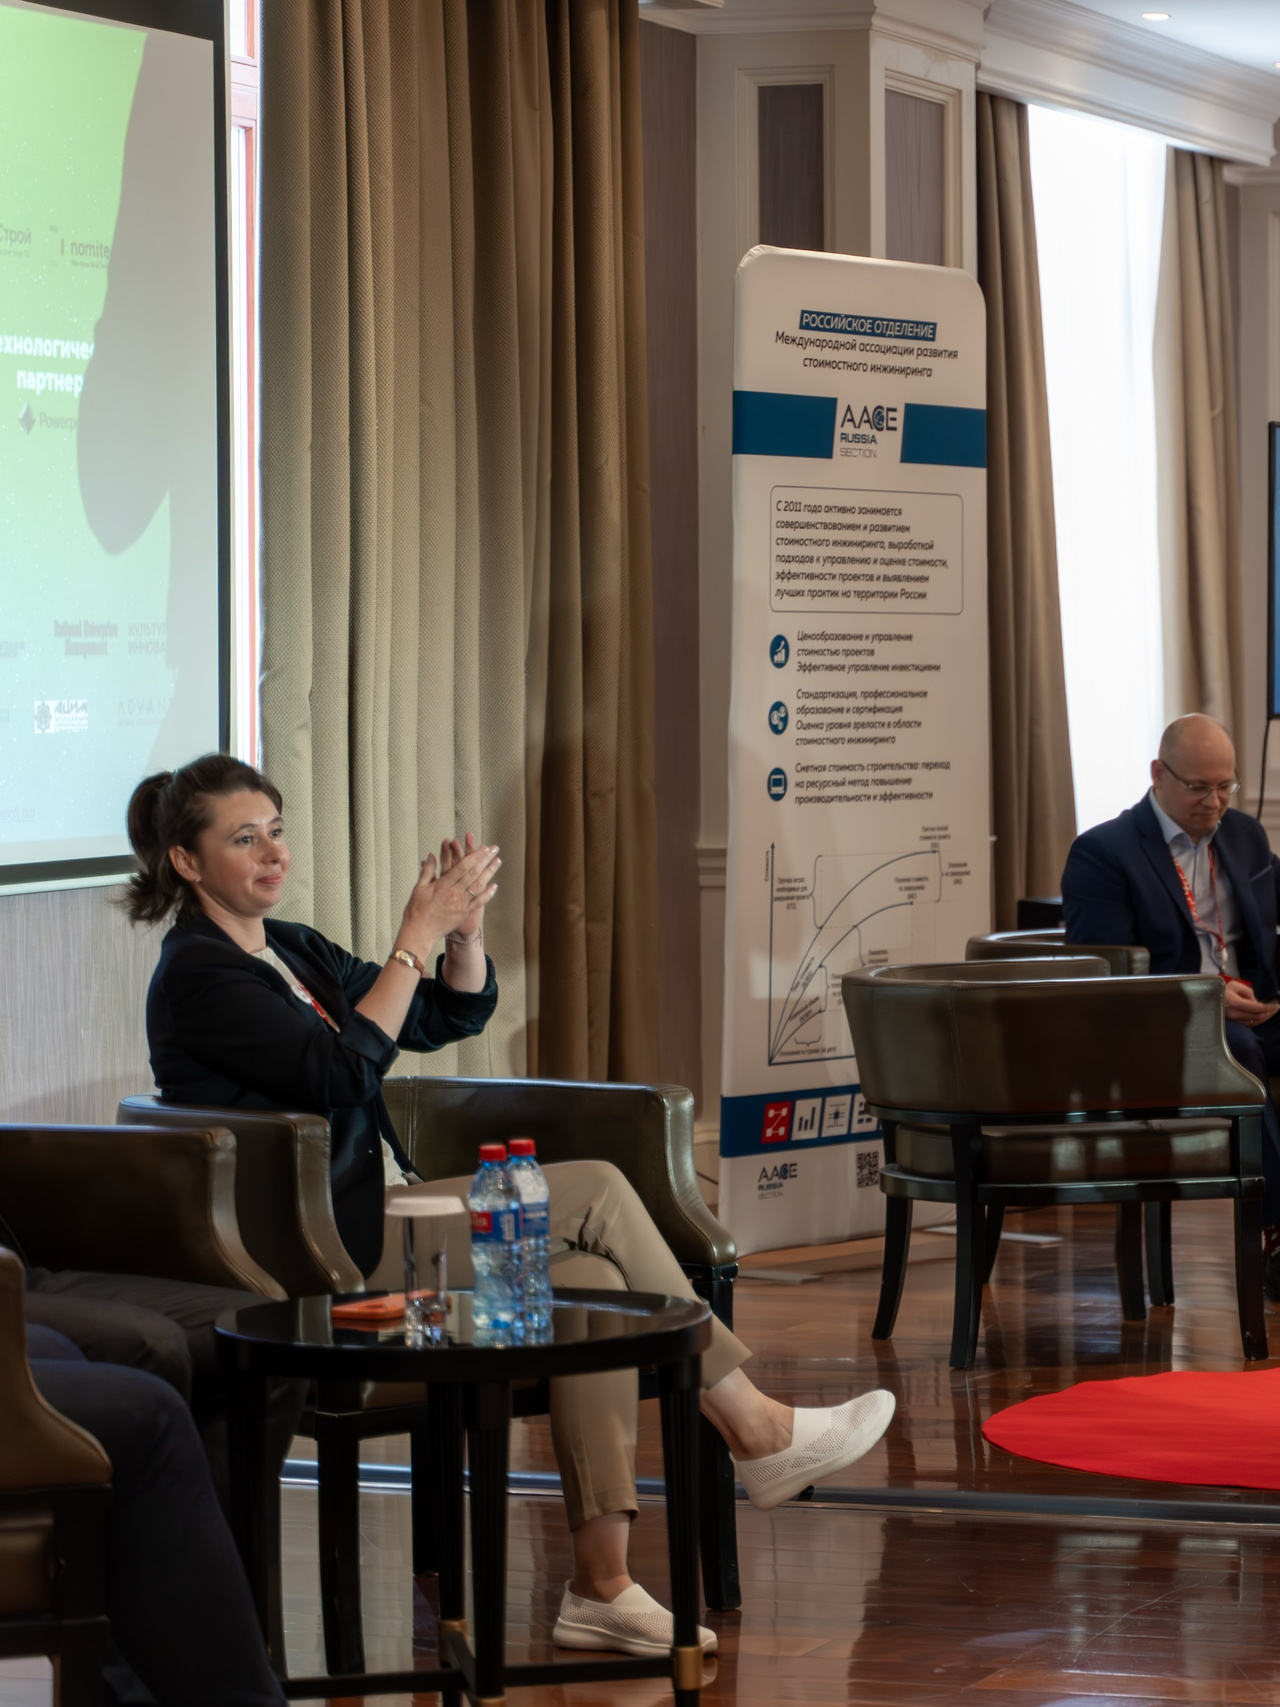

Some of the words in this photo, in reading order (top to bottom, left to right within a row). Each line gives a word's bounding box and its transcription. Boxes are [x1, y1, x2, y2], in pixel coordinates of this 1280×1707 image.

[802, 313, 872, 333] РОССИЙСКОЕ
[874, 322, 934, 338] ОТДЕЛЕНИЕ
[775, 331, 857, 351] Международной
[859, 342, 914, 357] ассоциации
[916, 347, 959, 360] развития
[803, 356, 868, 372] стоимостного
[870, 363, 932, 379] инжиниринга
[39, 411, 78, 432] Powerp
[841, 404, 898, 431] AACE
[840, 432, 877, 444] RUSSIA
[840, 447, 877, 459] SECTION
[776, 500, 782, 512] С
[783, 501, 802, 512] 2011
[803, 503, 822, 516] года
[823, 504, 856, 515] активно
[857, 506, 903, 517] занимается
[775, 519, 861, 532] совершенствованием
[862, 523, 868, 531] и
[869, 523, 910, 534] развитием
[775, 536, 830, 548] стоимостного
[831, 538, 887, 551] инжиниринга,
[888, 539, 934, 552] выработкой
[775, 554, 815, 565] подходов
[815, 555, 821, 563] к
[822, 555, 872, 567] управлению
[873, 557, 878, 565] и
[879, 557, 907, 567] оценке
[908, 559, 949, 569] стоимости,
[775, 569, 837, 584] эффективности
[838, 573, 875, 584] проектов
[882, 574, 930, 583] выявлением
[775, 588, 806, 600] лучших
[807, 589, 840, 600] практик
[841, 590, 851, 599] на
[853, 590, 899, 602] территории
[900, 588, 927, 599] России
[797, 631, 864, 643] Ценообразование
[871, 632, 914, 644] управление
[797, 648, 840, 657] стоимостью
[841, 648, 875, 658] проектов
[796, 661, 846, 674] Эффективное
[847, 663, 890, 674] управление
[891, 663, 941, 673] инвестициями
[796, 689, 859, 701] Стандартизация,
[860, 689, 928, 700] профессиональное
[796, 704, 844, 716] образование
[852, 704, 903, 716] сертификация
[796, 720, 824, 731] Оценка
[825, 721, 851, 733] уровня
[852, 720, 886, 731] зрелости
[892, 719, 922, 729] области
[795, 736, 846, 746] стоимостного
[847, 735, 896, 747] инжиниринга
[795, 762, 827, 773] Сметная
[828, 762, 865, 773] стоимость
[920, 760, 951, 771] переход
[795, 779, 805, 789] на
[805, 777, 847, 790] ресурсный
[847, 778, 870, 788] метод
[870, 777, 912, 787] повышение
[794, 792, 872, 807] производительности
[878, 791, 934, 805] эффективности
[758, 1163, 798, 1183] AACE
